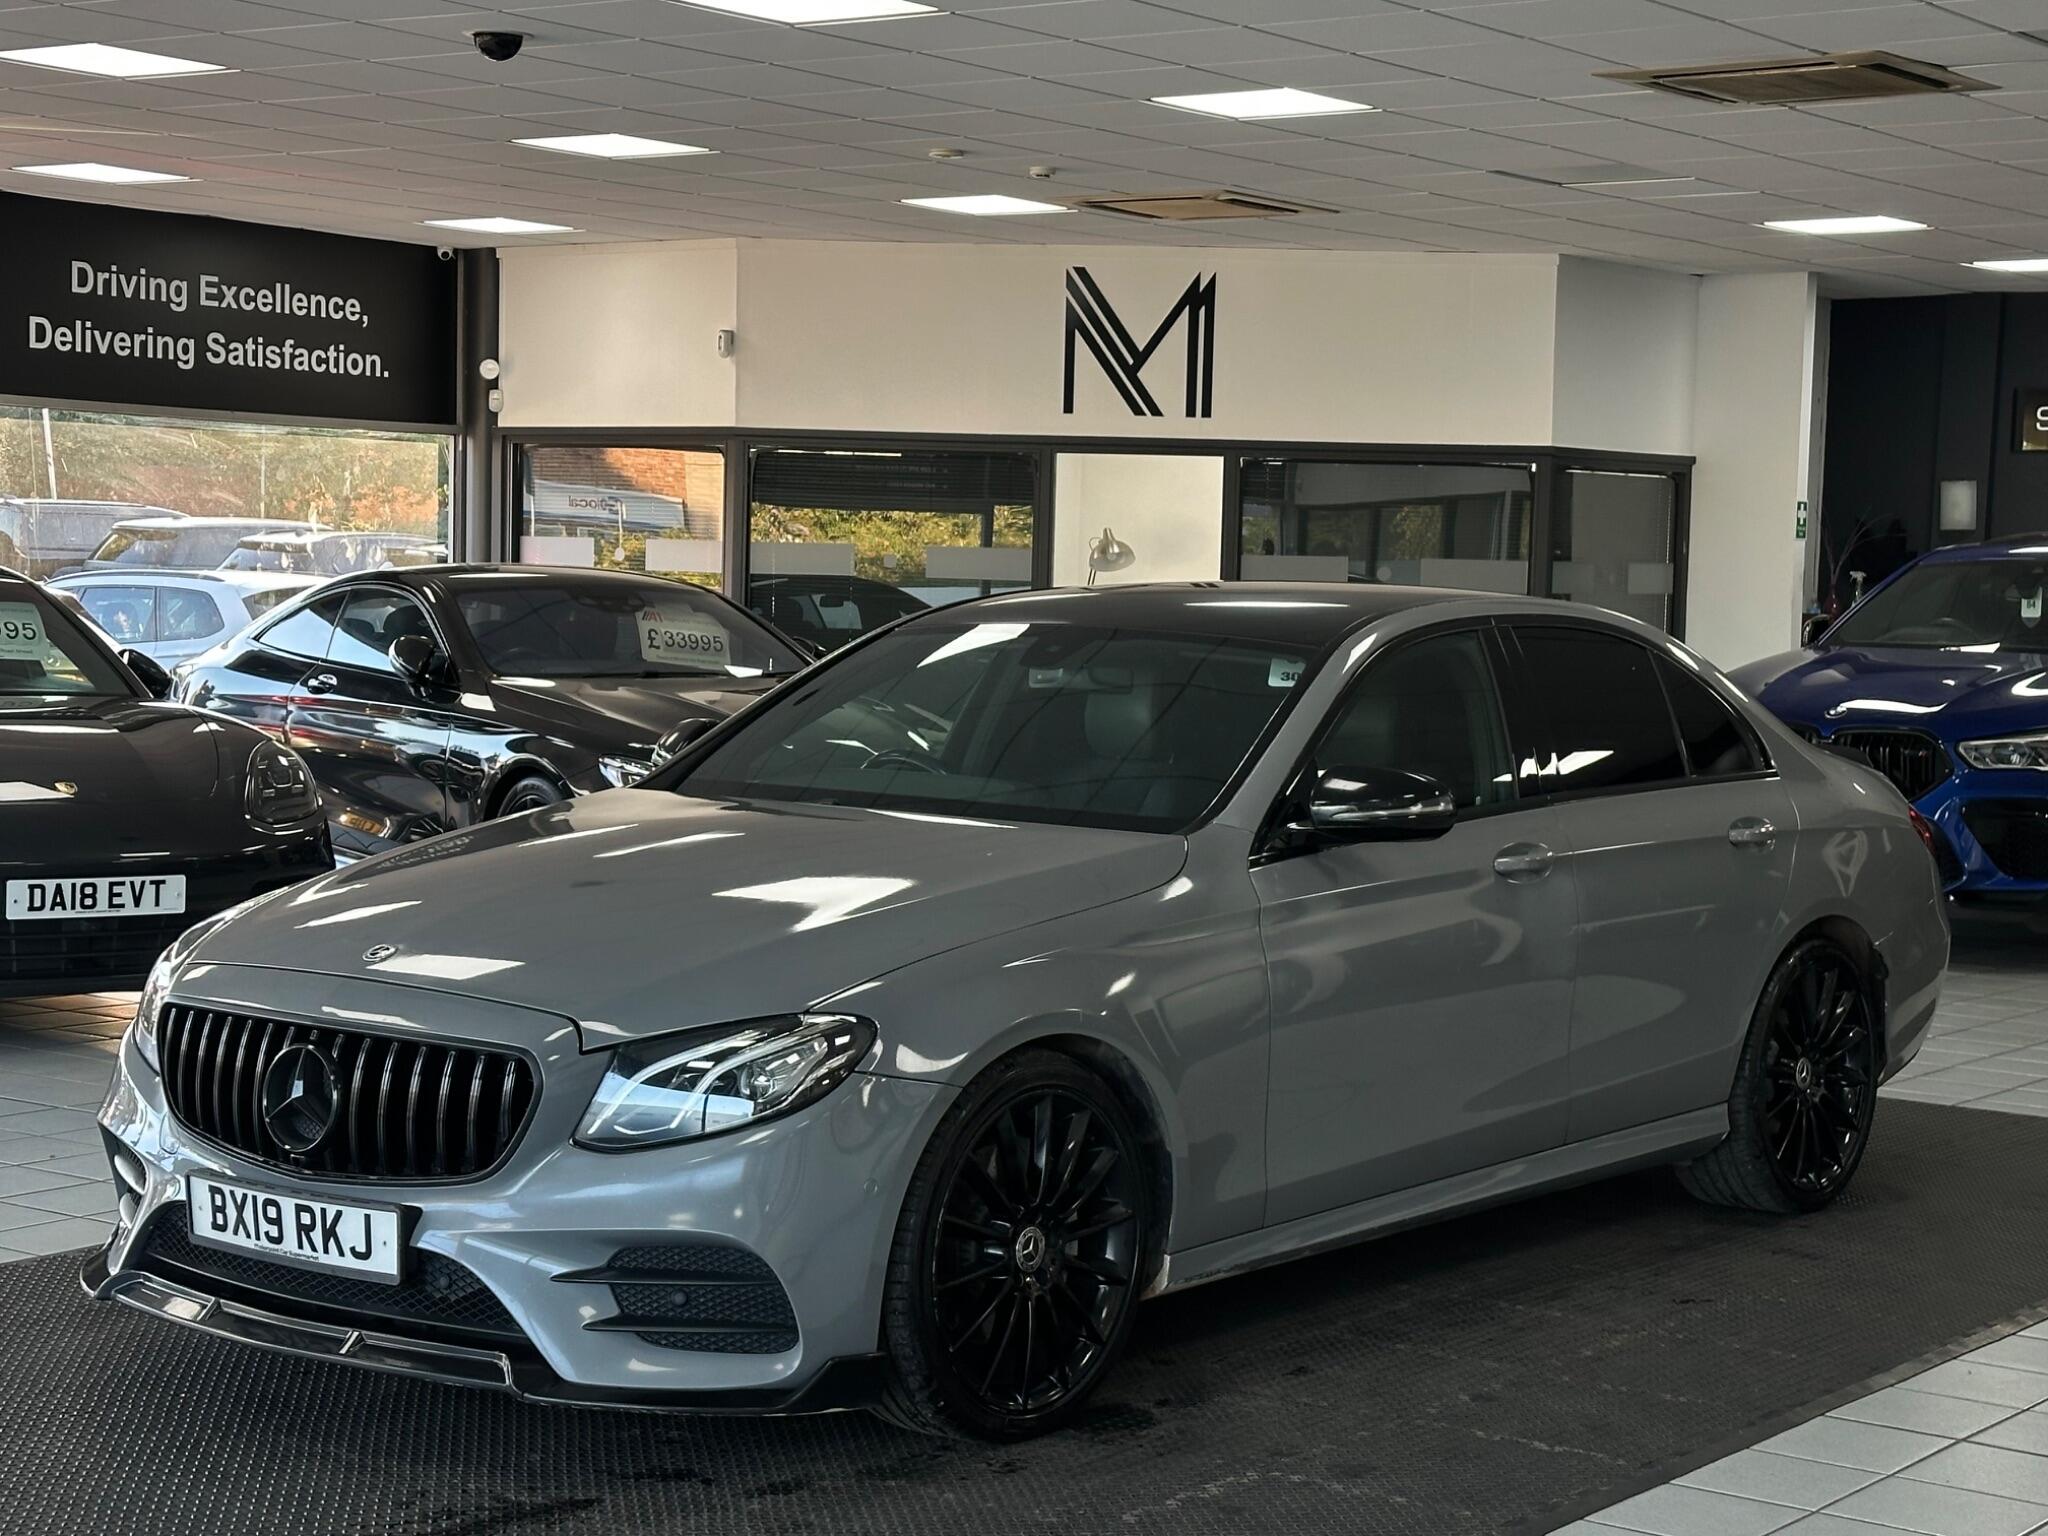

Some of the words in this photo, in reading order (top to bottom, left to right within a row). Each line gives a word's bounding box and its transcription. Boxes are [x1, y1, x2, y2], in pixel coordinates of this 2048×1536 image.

[70, 260, 188, 312] Driving
[199, 274, 368, 328] Excellence,
[28, 315, 195, 369] Delivering
[205, 331, 389, 378] Satisfaction.
[0, 621, 36, 640] 95
[27, 882, 97, 912] DA18
[107, 879, 166, 909] EVT
[208, 1184, 284, 1245] BX19
[294, 1202, 372, 1261] RKJ
